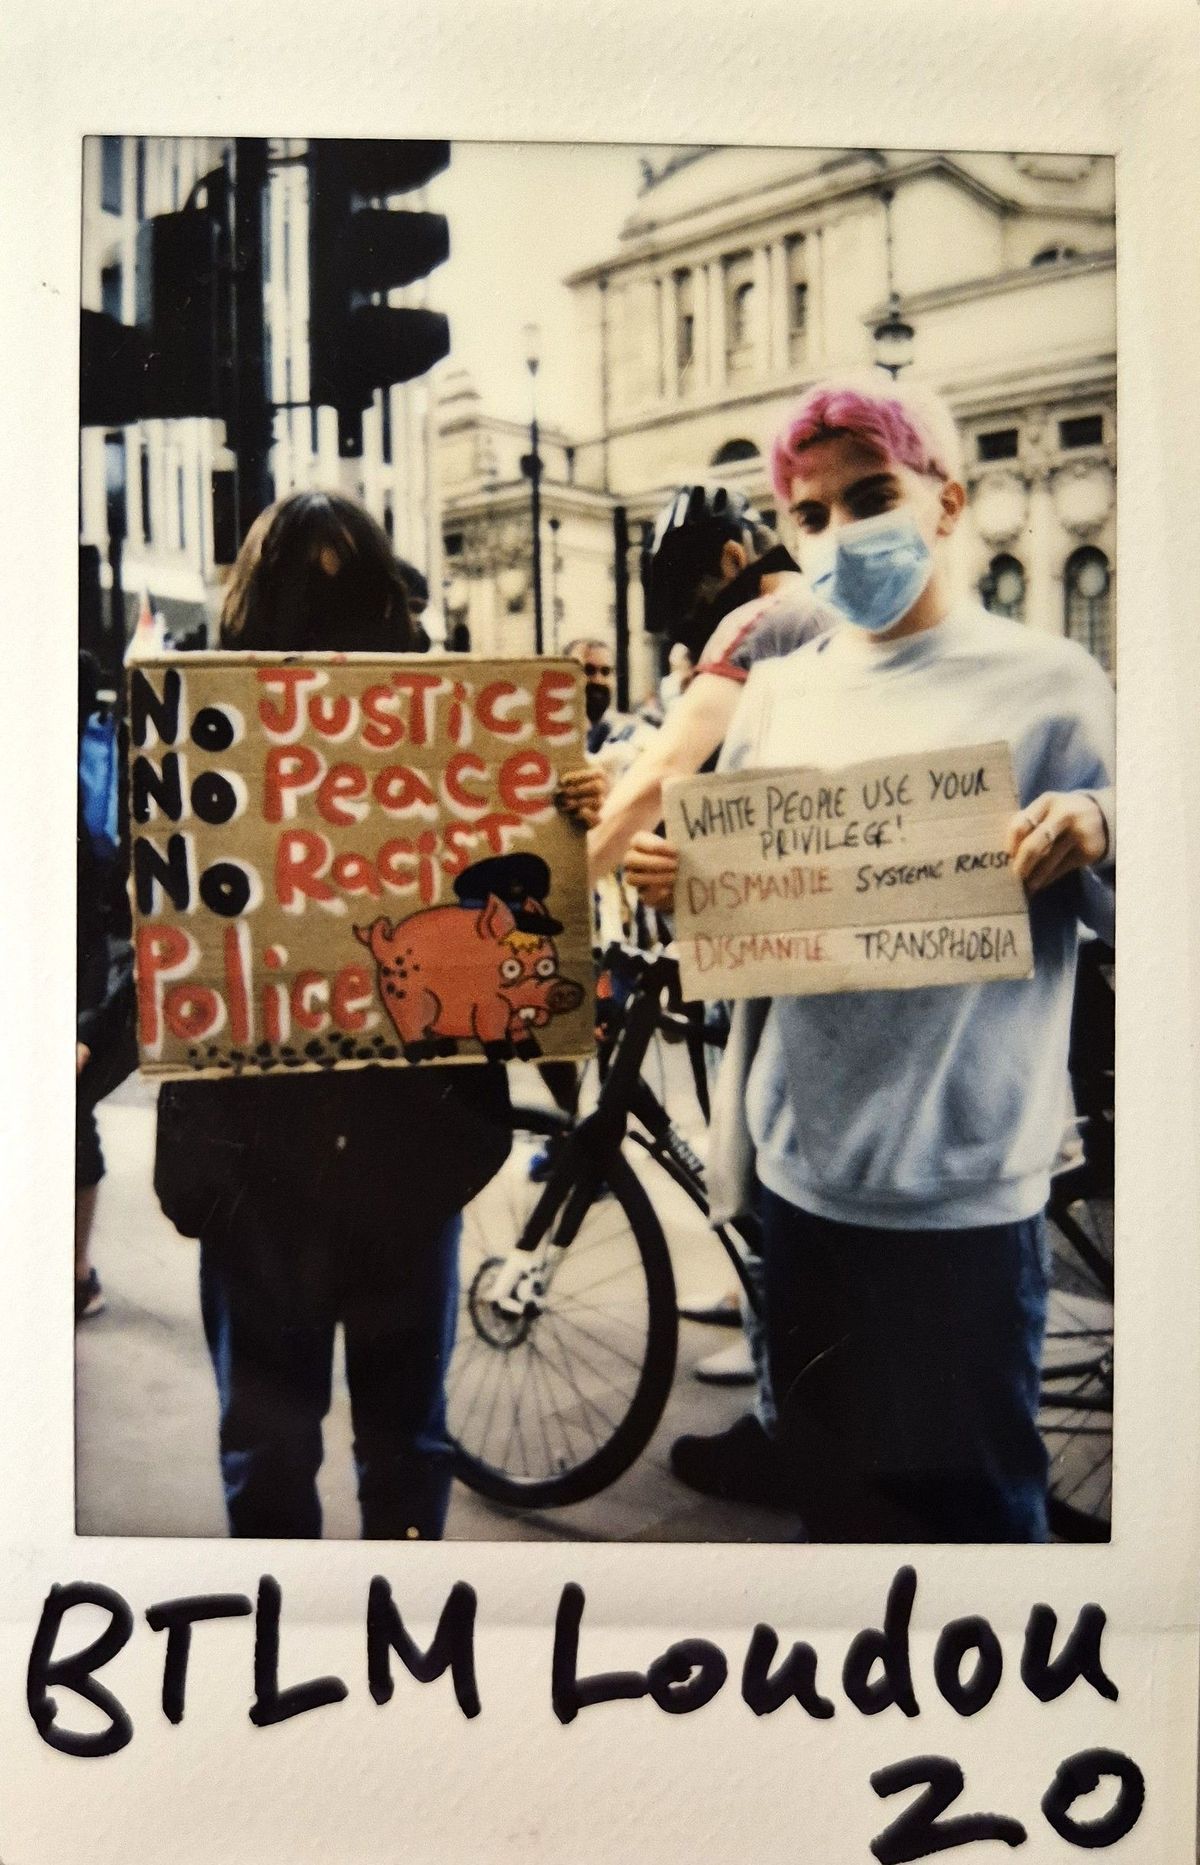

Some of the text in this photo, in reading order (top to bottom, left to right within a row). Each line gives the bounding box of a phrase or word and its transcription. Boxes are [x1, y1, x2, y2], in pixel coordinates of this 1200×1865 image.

[262, 745, 555, 826] Peace
[680, 767, 990, 841] WHITE PEOPLE USE YOUR
[760, 814, 907, 861] PRIVILEGE!
[686, 866, 833, 915] DISMANTLE
[856, 860, 944, 893] SYSTEMIC
[137, 923, 376, 1050] Police
[694, 926, 1017, 972] DISMANTLE TRANSPHOBIA
[27, 1576, 481, 1758] BTLM
[870, 1749, 1146, 1865] 20
